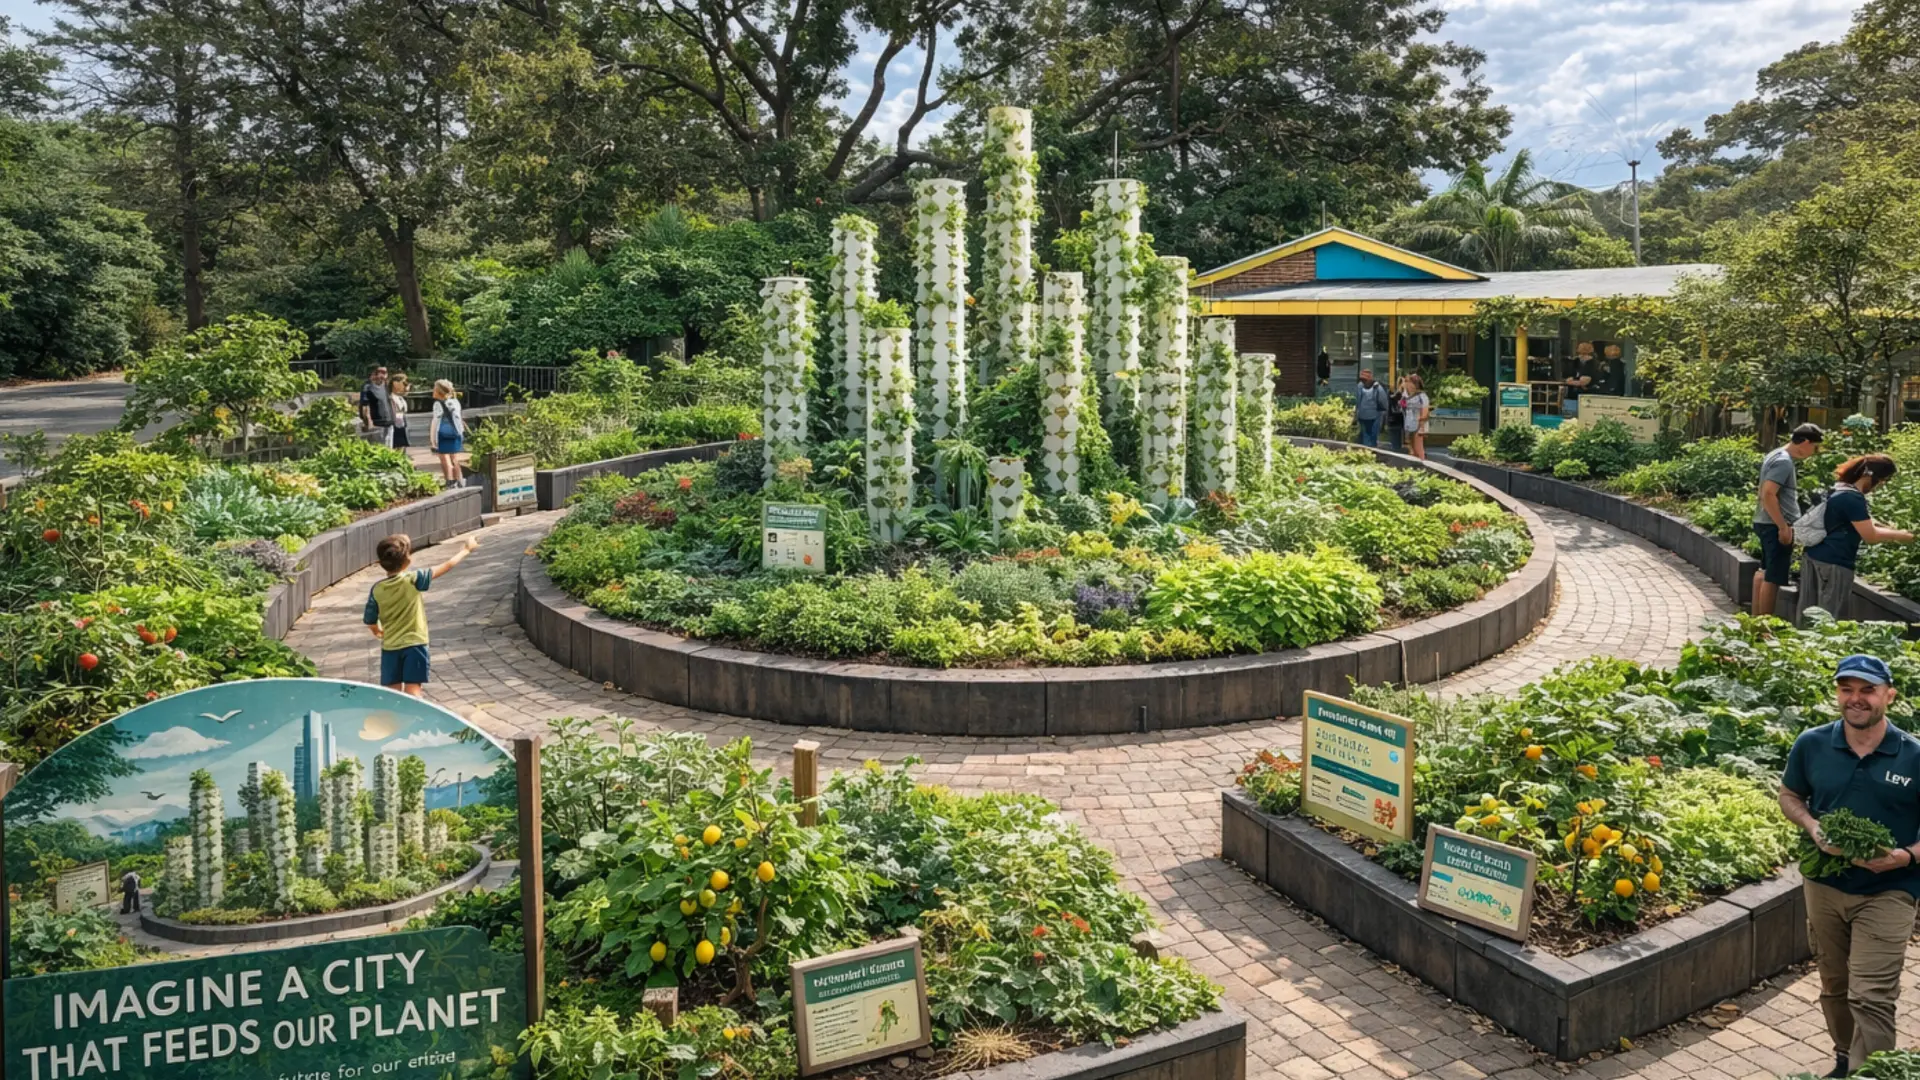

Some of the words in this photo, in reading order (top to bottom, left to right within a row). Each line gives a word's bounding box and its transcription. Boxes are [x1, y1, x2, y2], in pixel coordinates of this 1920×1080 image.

[53, 969, 263, 1030] IMAGINE
[277, 966, 309, 1002] A
[322, 949, 426, 995] CITY
[22, 1036, 128, 1080] THAT
[143, 1019, 261, 1067] FEEDS
[273, 1014, 337, 1050] OUR
[350, 988, 506, 1040] PLANET
[338, 1063, 365, 1079] for
[372, 1060, 402, 1074] our
